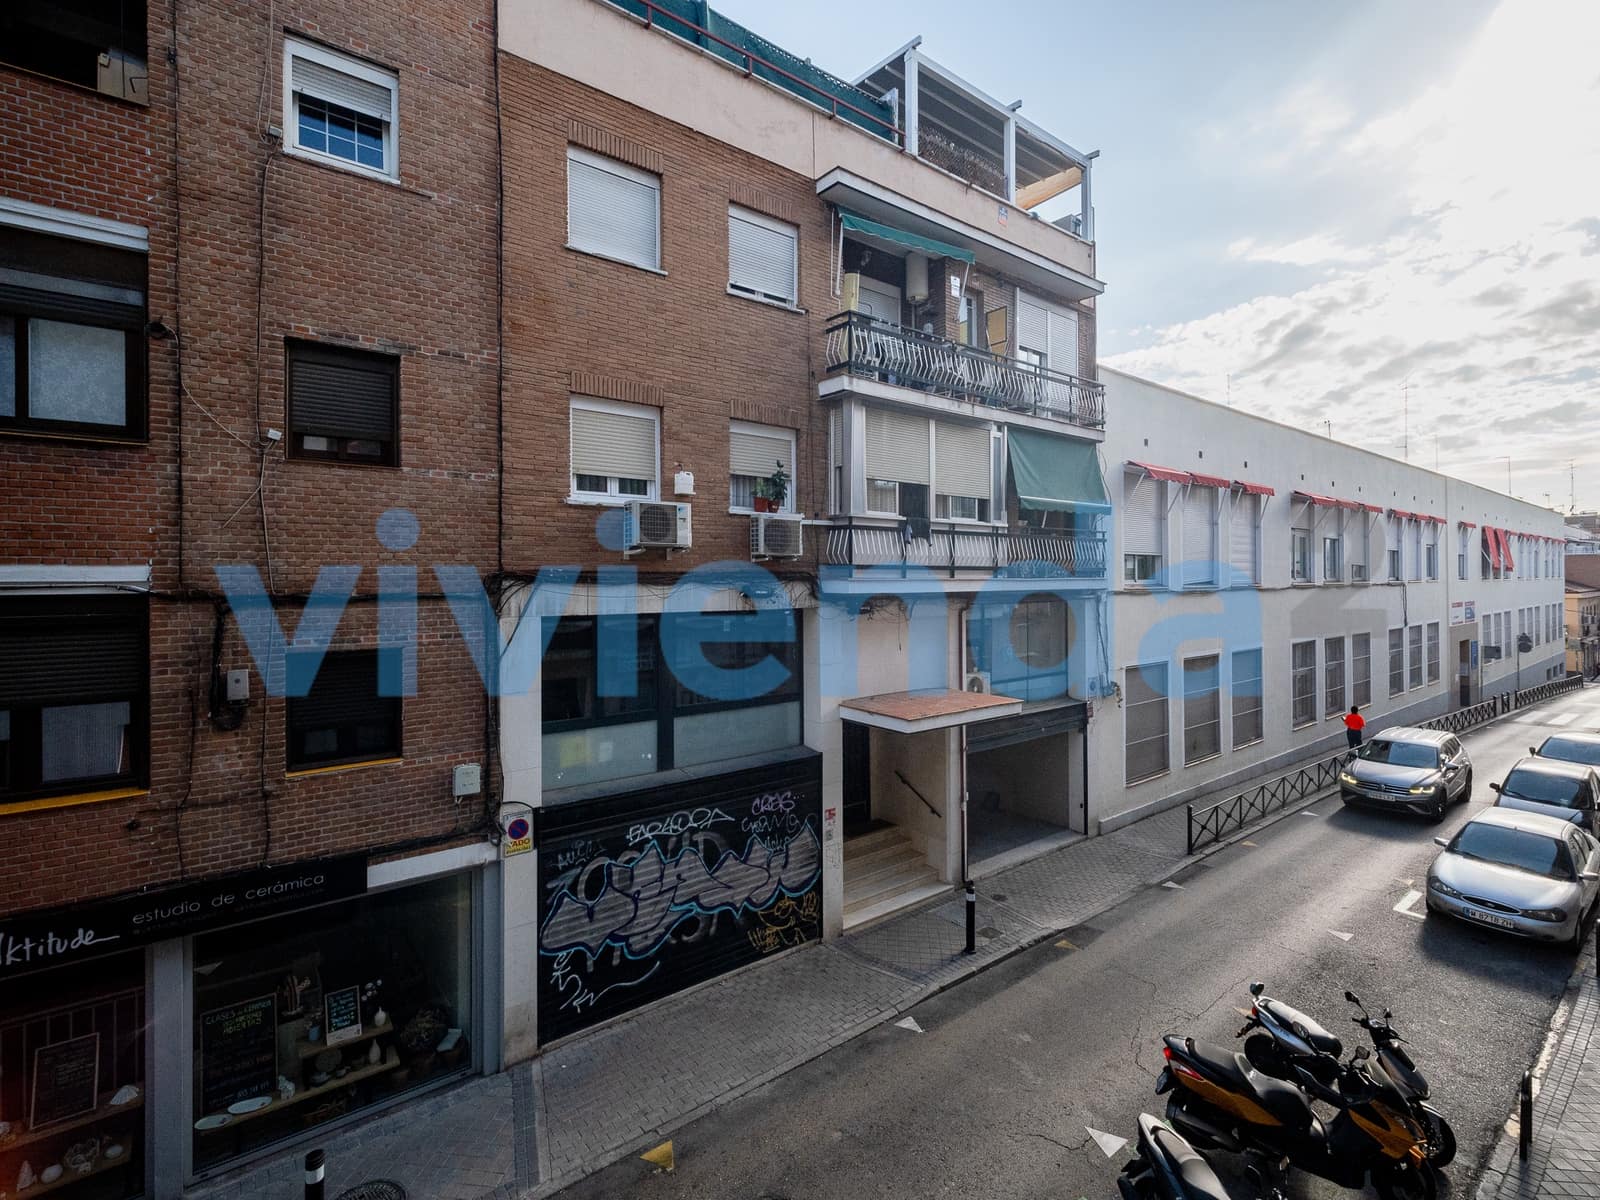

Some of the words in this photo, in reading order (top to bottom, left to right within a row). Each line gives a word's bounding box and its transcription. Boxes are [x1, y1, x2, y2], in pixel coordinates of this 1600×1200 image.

[132, 899, 201, 925] estudio
[210, 891, 236, 908] de
[244, 873, 326, 900] cerámica
